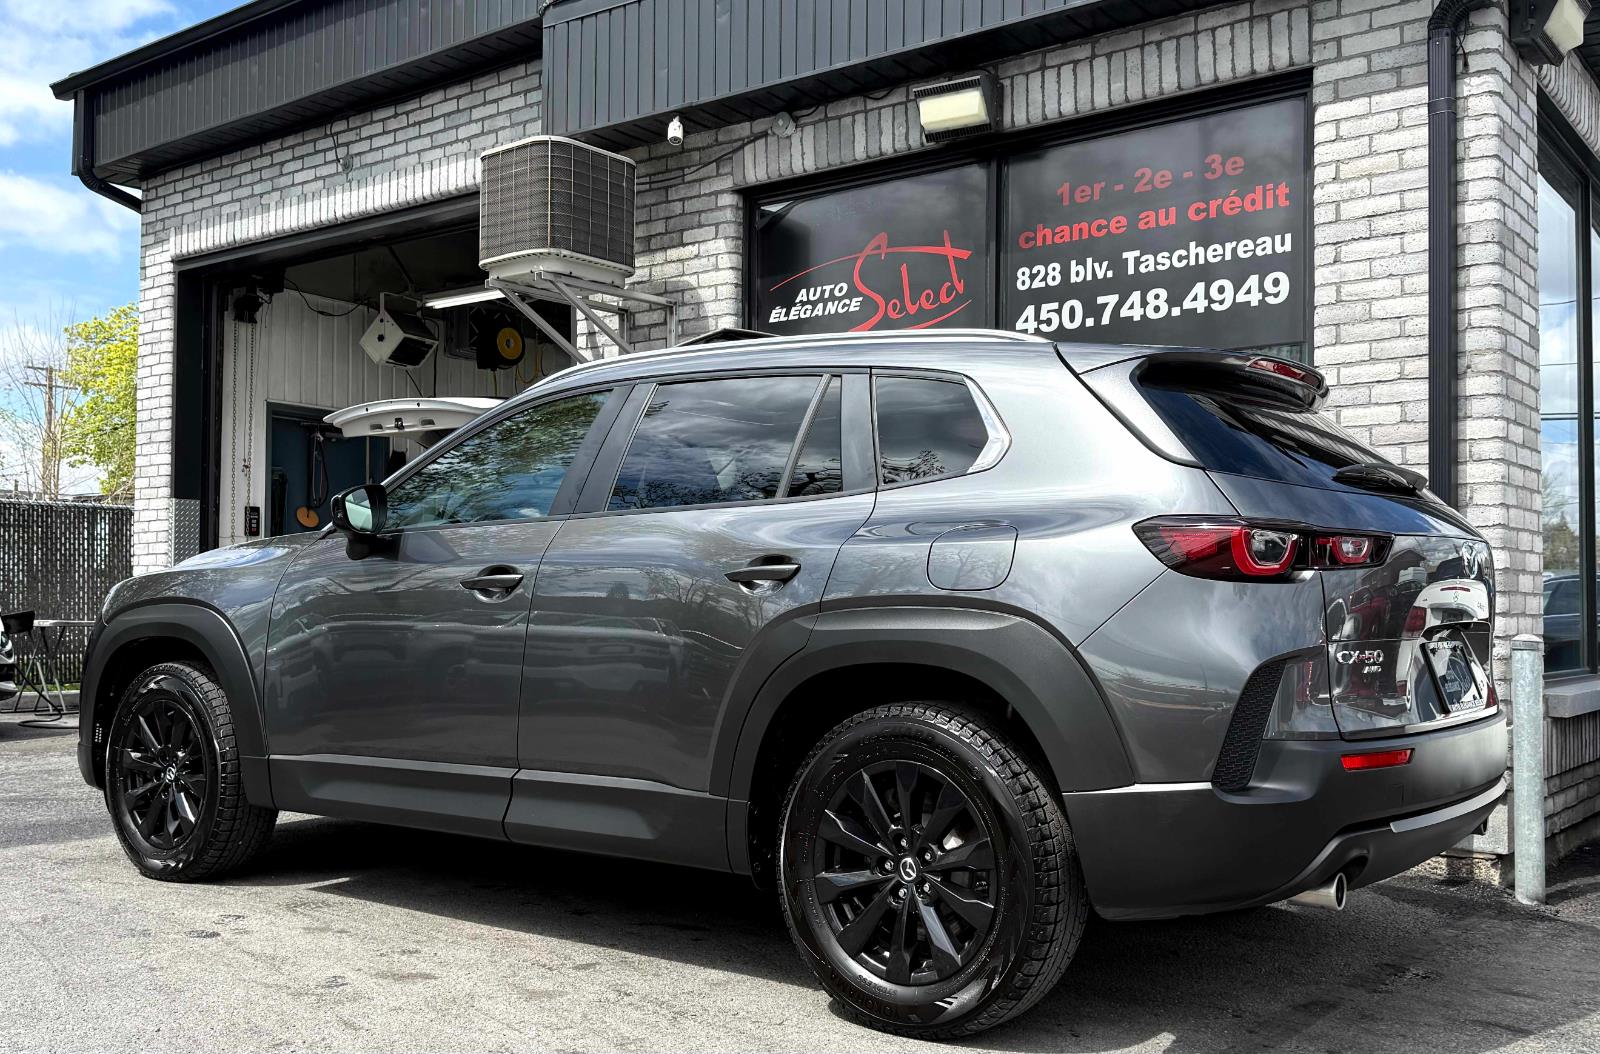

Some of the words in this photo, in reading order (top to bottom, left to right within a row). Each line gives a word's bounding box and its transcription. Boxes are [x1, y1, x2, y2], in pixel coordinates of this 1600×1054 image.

[1056, 179, 1106, 206] 1er
[1134, 167, 1173, 193] 2e
[1203, 153, 1245, 180] 3e
[1018, 214, 1128, 249] chance
[1138, 206, 1176, 231] au
[1187, 181, 1290, 221] crédit
[795, 282, 849, 303] AUTO
[848, 229, 973, 332] Select
[1015, 262, 1062, 291] 828
[1069, 257, 1114, 284] blv.
[1122, 232, 1292, 276] Taschereau
[768, 297, 864, 323] ÉLÉGANCE
[1015, 270, 1291, 335] 450.748.4949
[1336, 649, 1385, 665] CX-50
